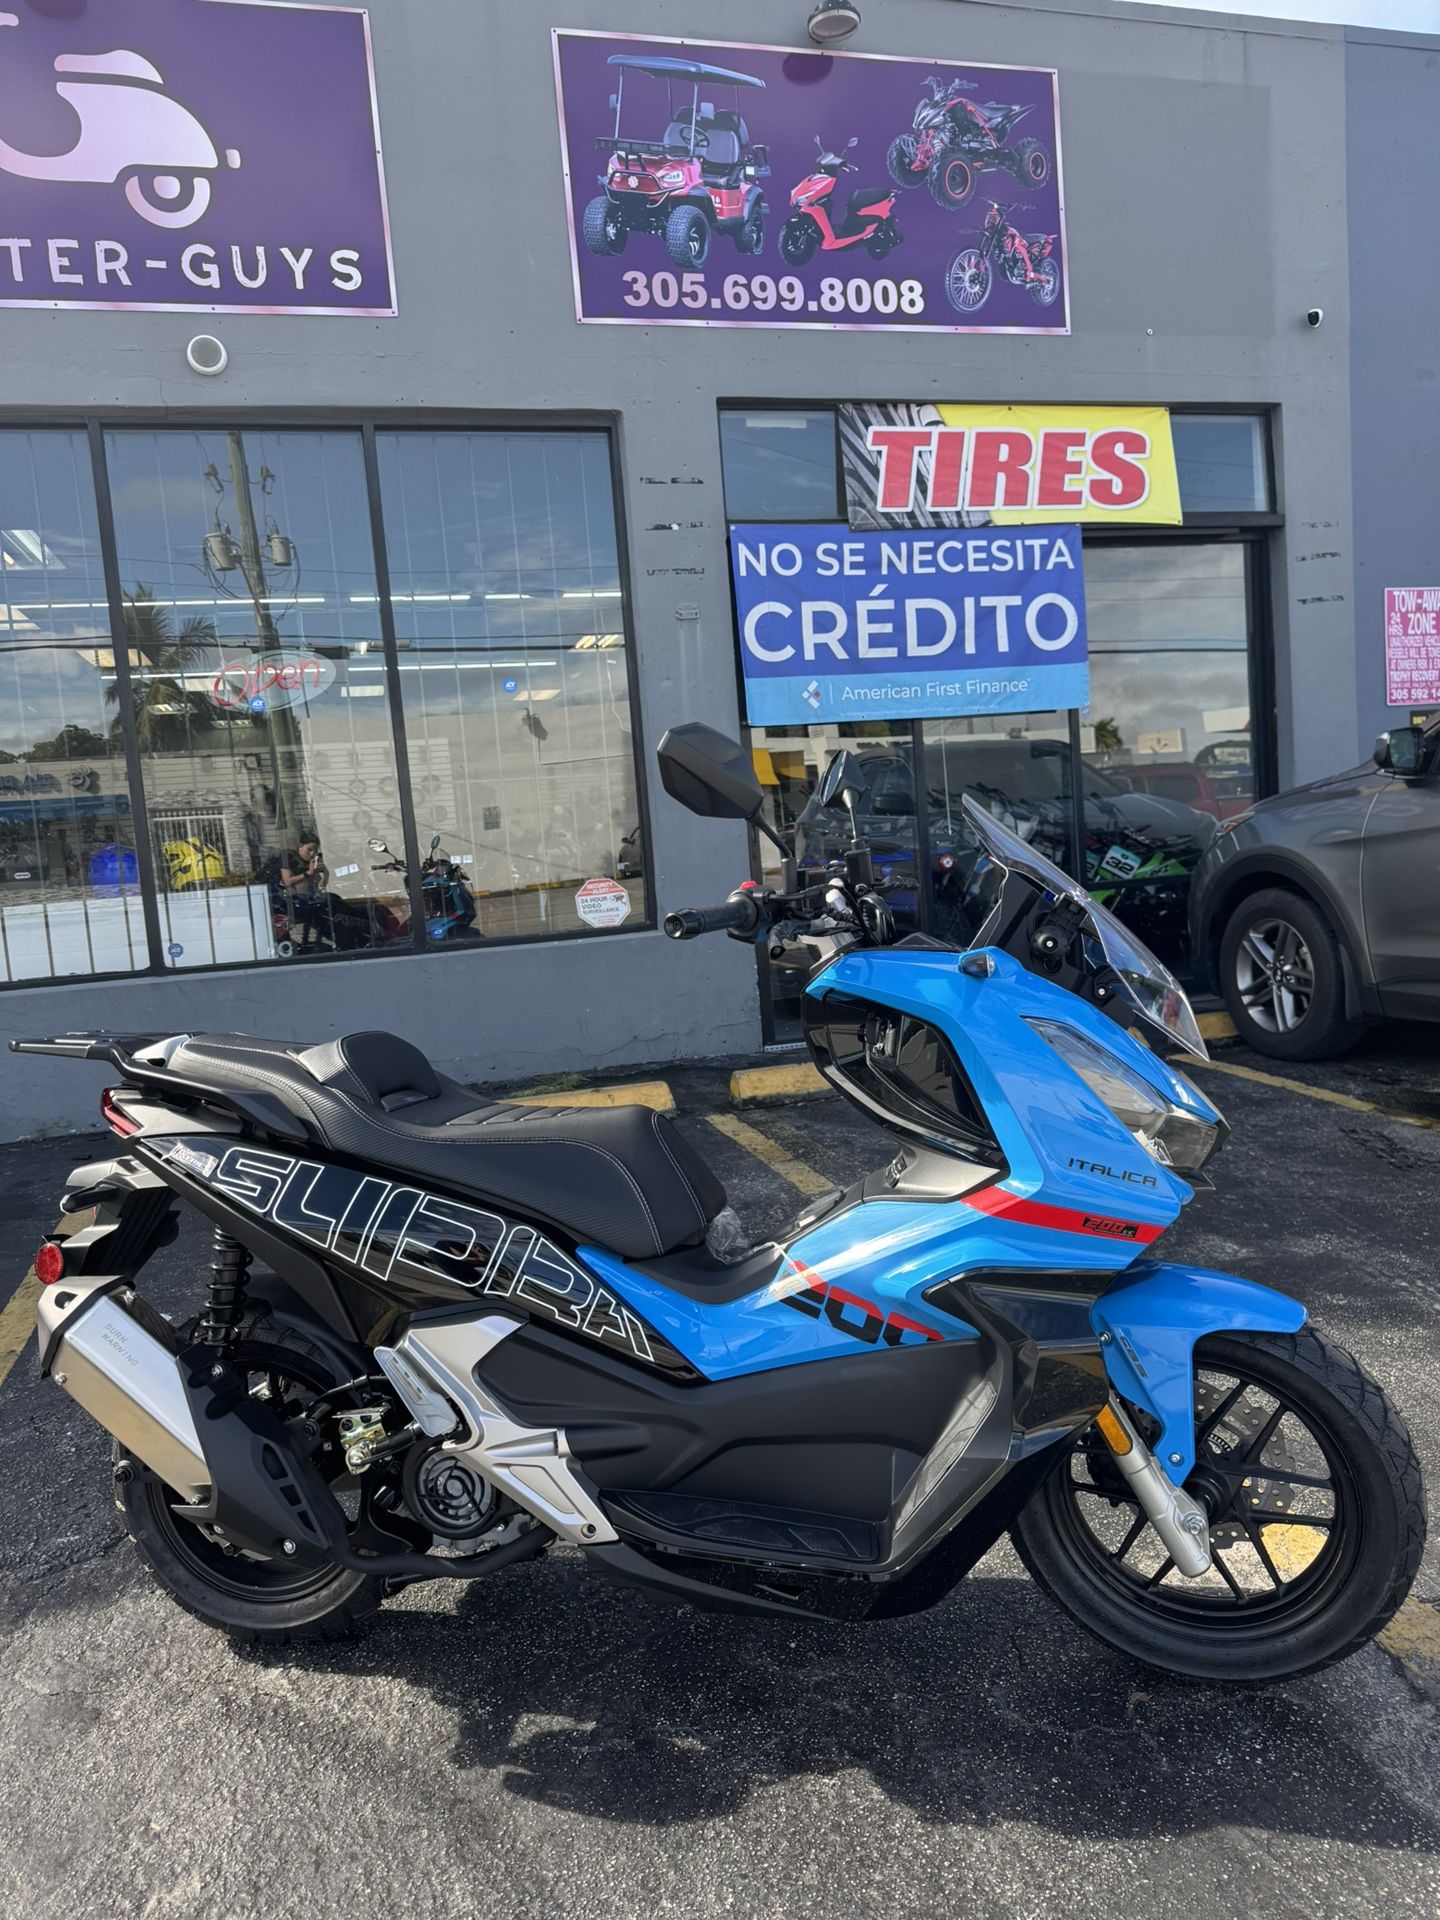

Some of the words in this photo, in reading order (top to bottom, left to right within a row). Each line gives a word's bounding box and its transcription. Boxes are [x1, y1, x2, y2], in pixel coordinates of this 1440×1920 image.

[622, 270, 925, 315] 305.699.8008
[868, 427, 1150, 511] TIRES
[738, 543, 803, 577] NO
[816, 542, 866, 576] SE
[880, 538, 1075, 575] NECESITA
[743, 583, 1079, 662] CRÉDITO
[1407, 612, 1436, 635] ZONE
[214, 658, 320, 706] Open
[841, 683, 921, 700] American
[926, 681, 961, 697] First
[1410, 688, 1429, 699] 592
[1105, 856, 1135, 876] 32
[1068, 1157, 1157, 1187] ITALICA
